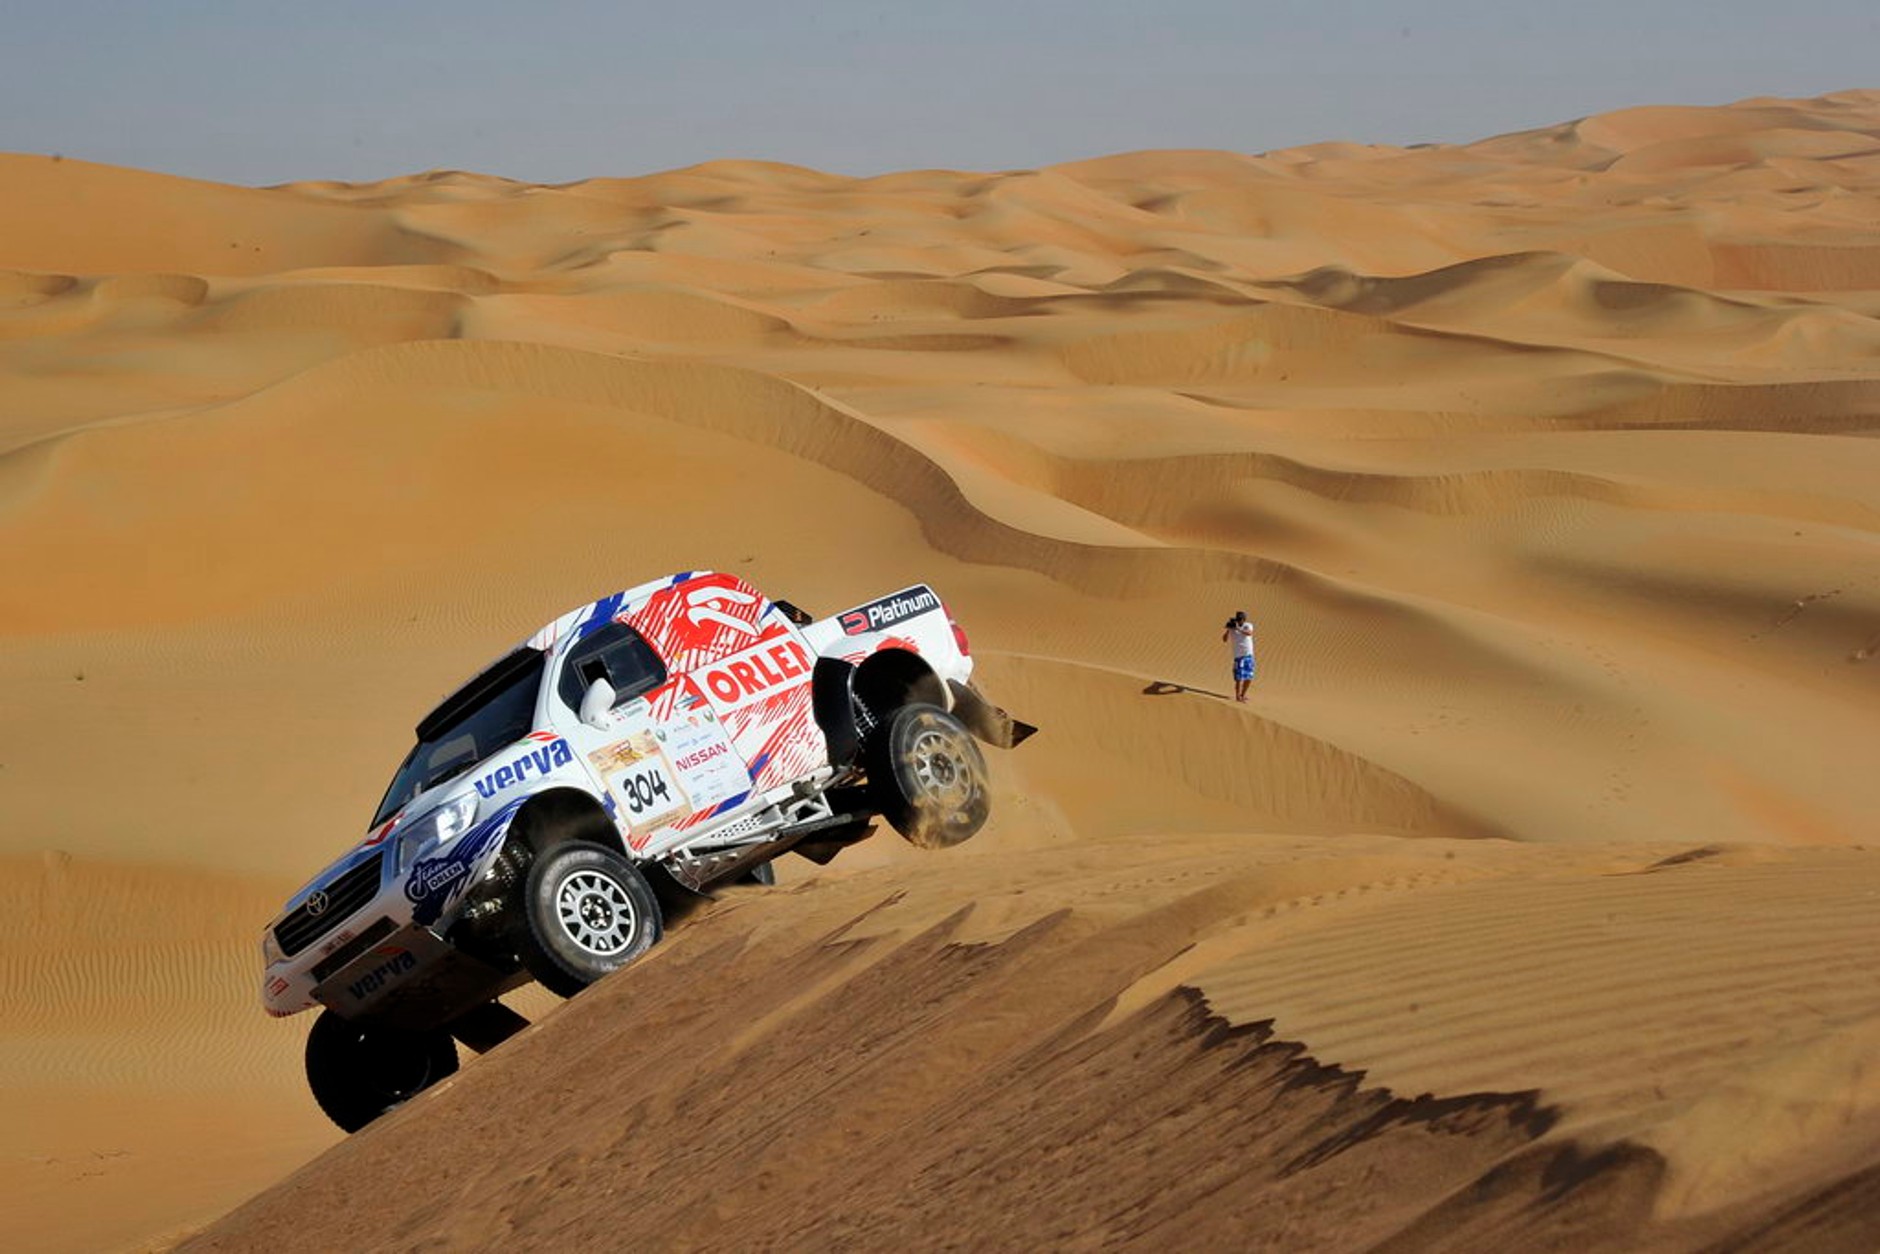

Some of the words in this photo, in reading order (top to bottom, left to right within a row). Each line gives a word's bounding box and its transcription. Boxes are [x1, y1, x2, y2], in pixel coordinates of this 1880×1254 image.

[868, 592, 934, 627] Platinum
[475, 738, 573, 798] verva
[676, 741, 728, 772] NISSAN
[623, 769, 671, 814] 304
[349, 951, 417, 1000] verva
